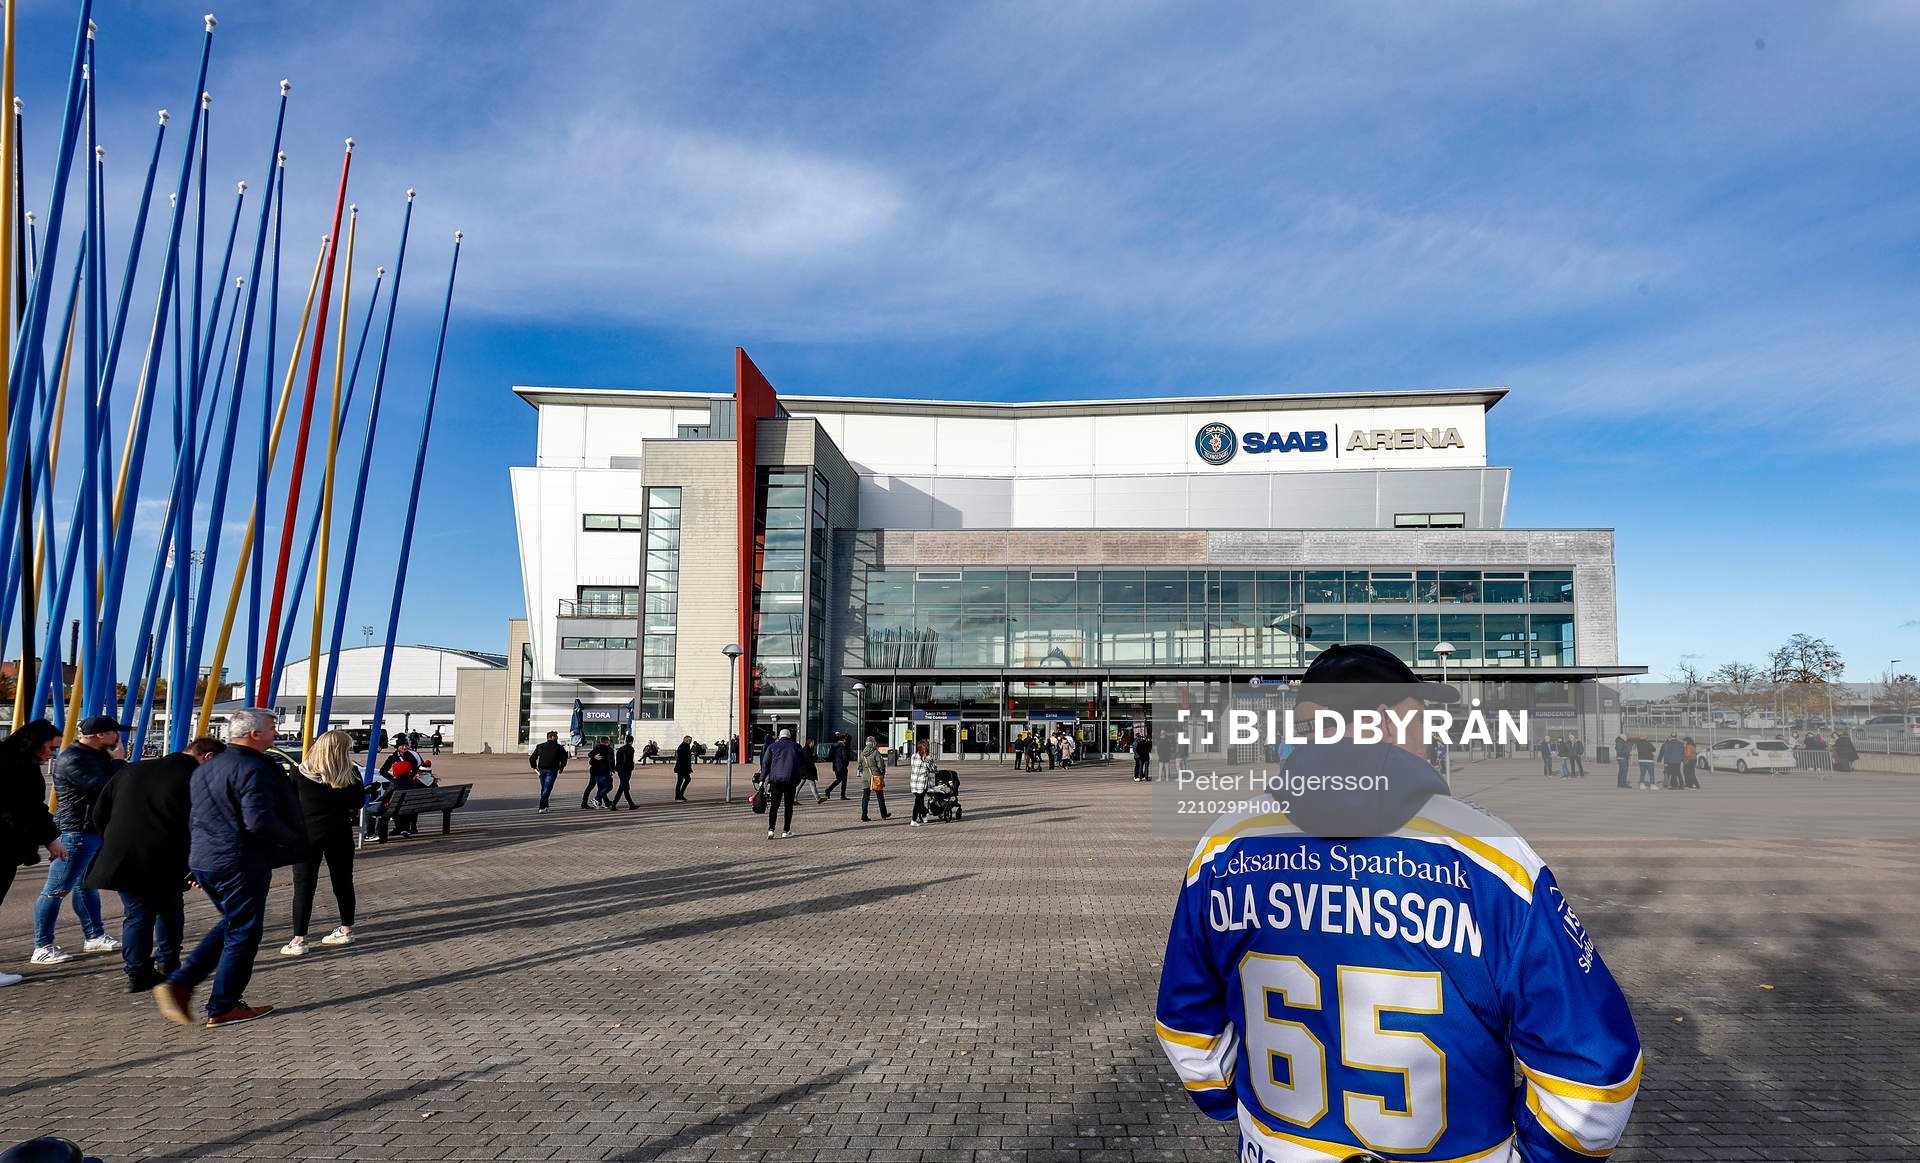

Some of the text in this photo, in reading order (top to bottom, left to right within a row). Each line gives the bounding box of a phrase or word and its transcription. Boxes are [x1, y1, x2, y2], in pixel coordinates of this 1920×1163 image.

[1243, 427, 1465, 454] SAAB ARENA
[1330, 845, 1471, 890] Sparbank
[1209, 882, 1482, 957] OLA SVENSSON
[1238, 950, 1447, 1154] 65
